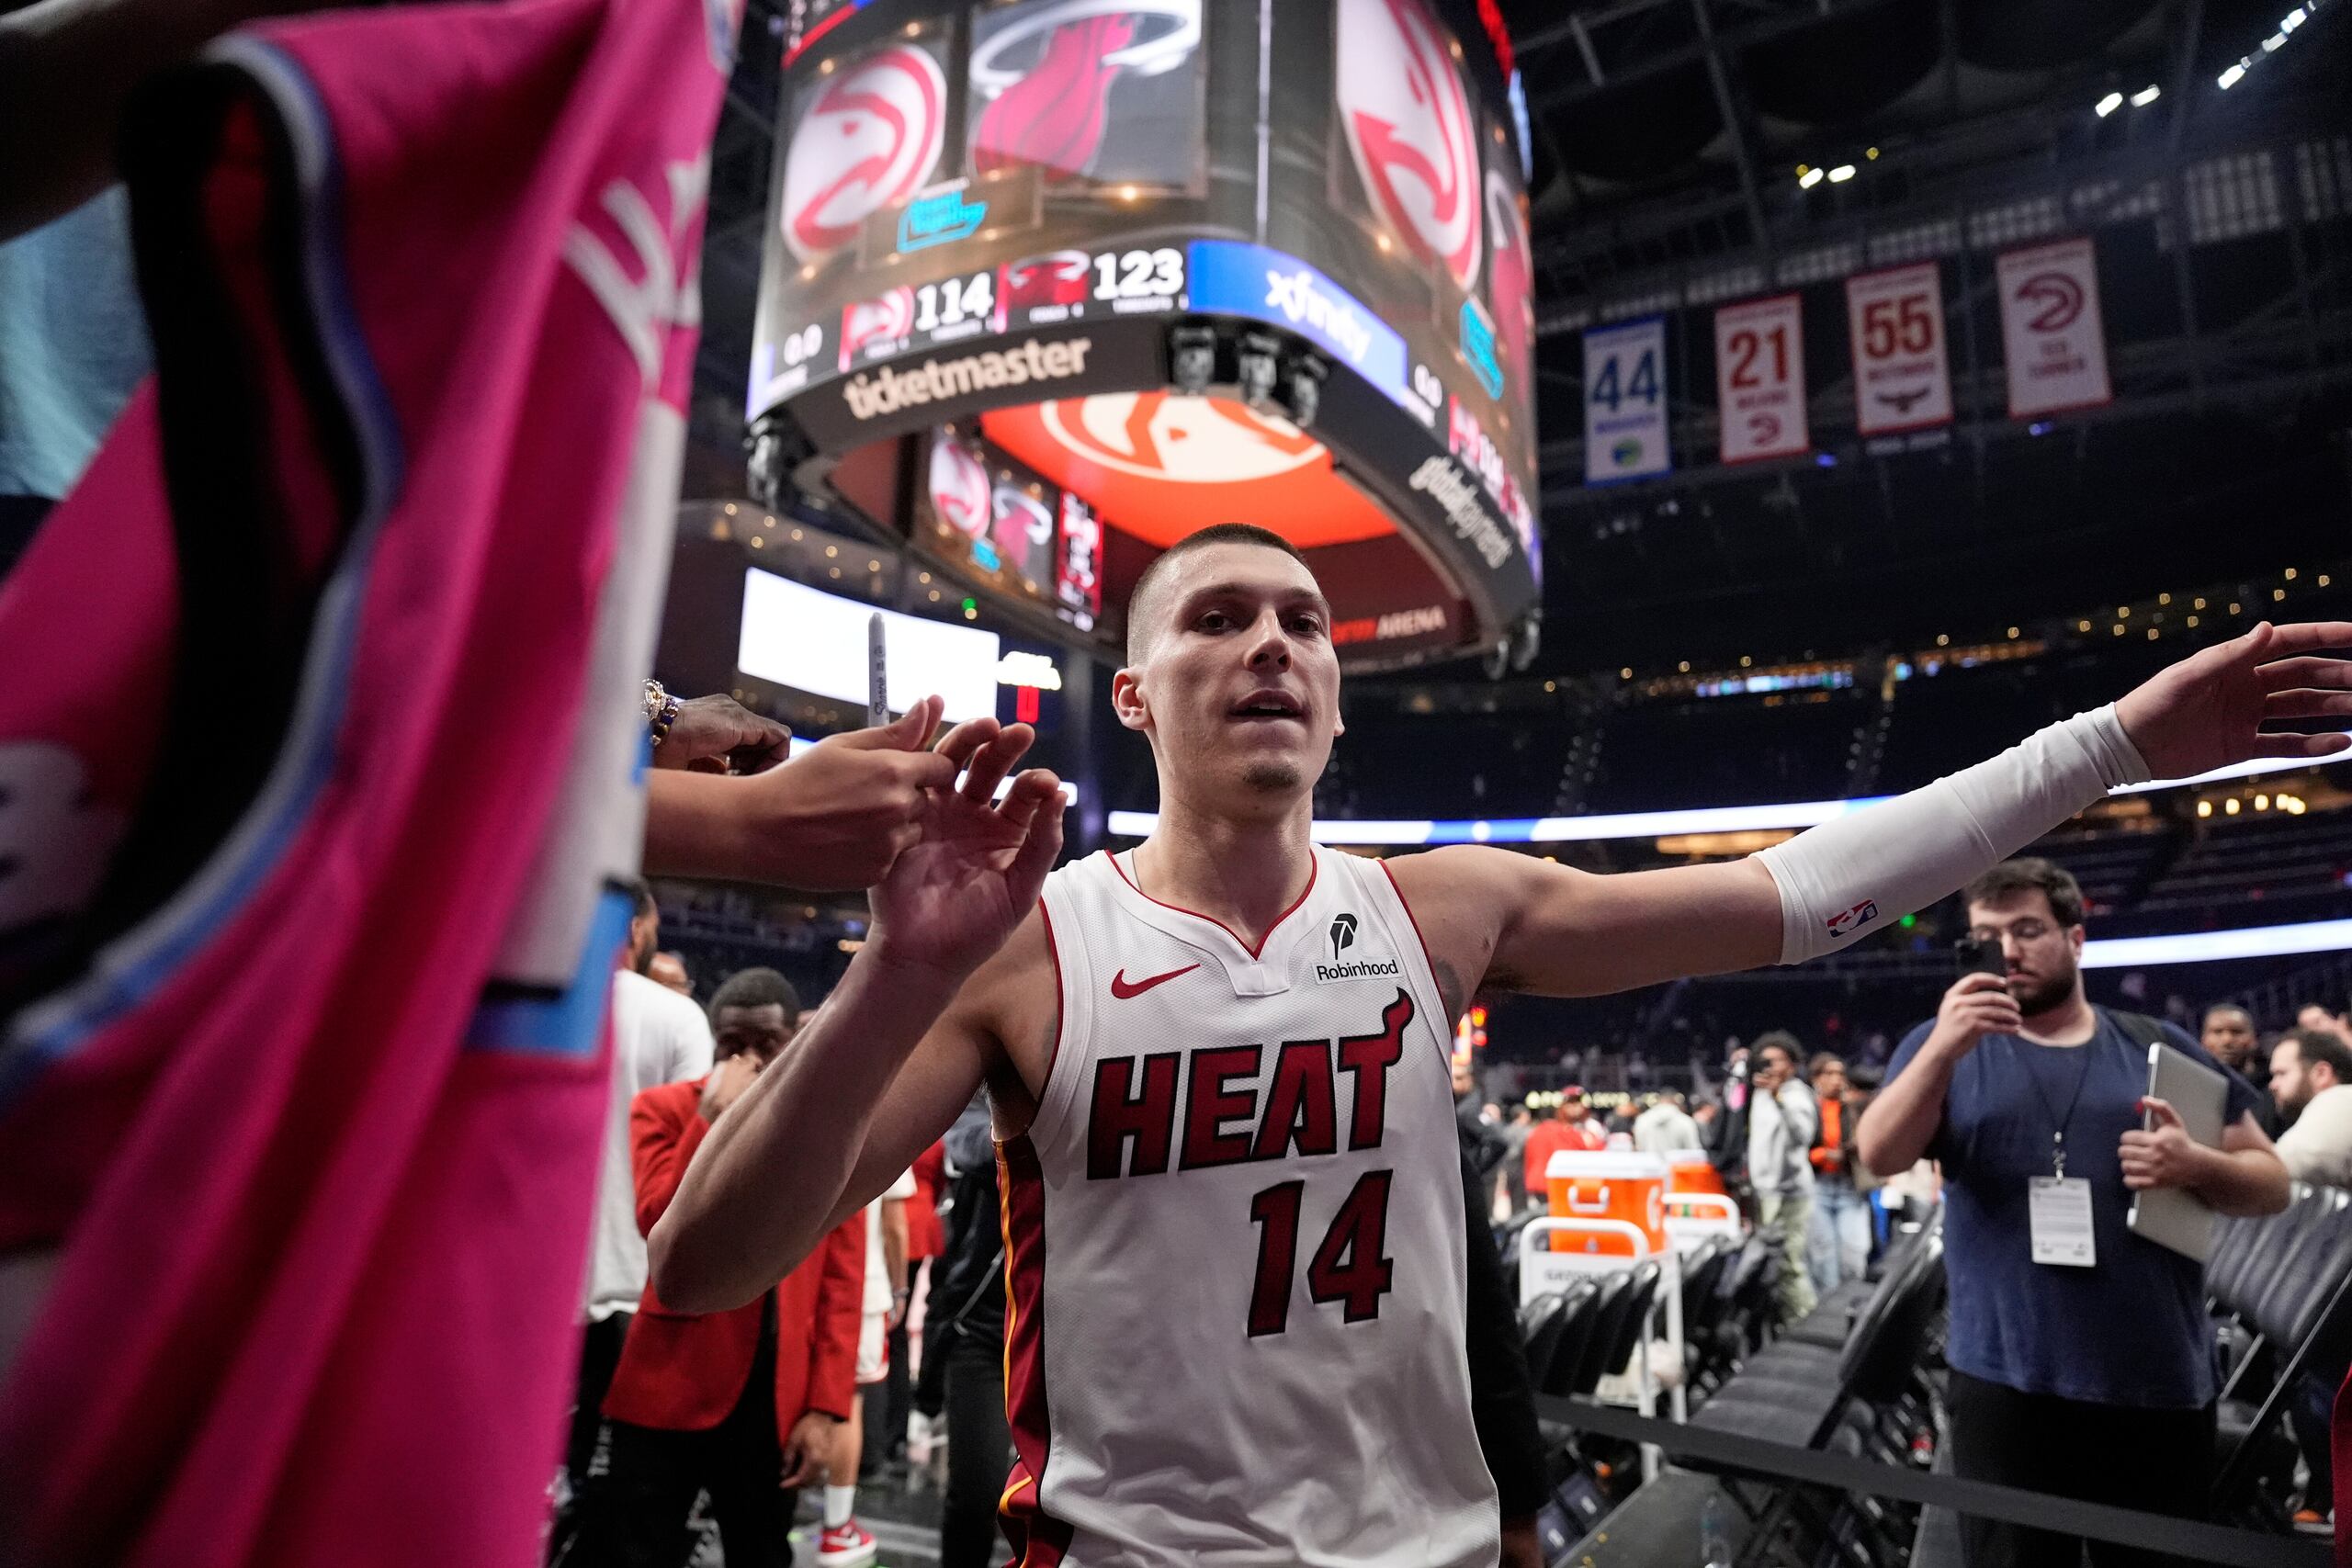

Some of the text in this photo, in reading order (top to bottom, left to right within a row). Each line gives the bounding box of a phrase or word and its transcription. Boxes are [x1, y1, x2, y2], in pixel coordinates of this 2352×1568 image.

[916, 273, 993, 332] 114
[1093, 247, 1184, 301] 123
[1728, 323, 1788, 389] 21
[1862, 293, 1933, 360] 55
[842, 337, 1092, 421] ticketmaster
[1593, 347, 1658, 412] 44
[1376, 604, 1448, 641] ARENA
[1316, 959, 1398, 980] Robinhood
[1087, 986, 1415, 1181] HEAT
[1247, 1168, 1394, 1338] 14
